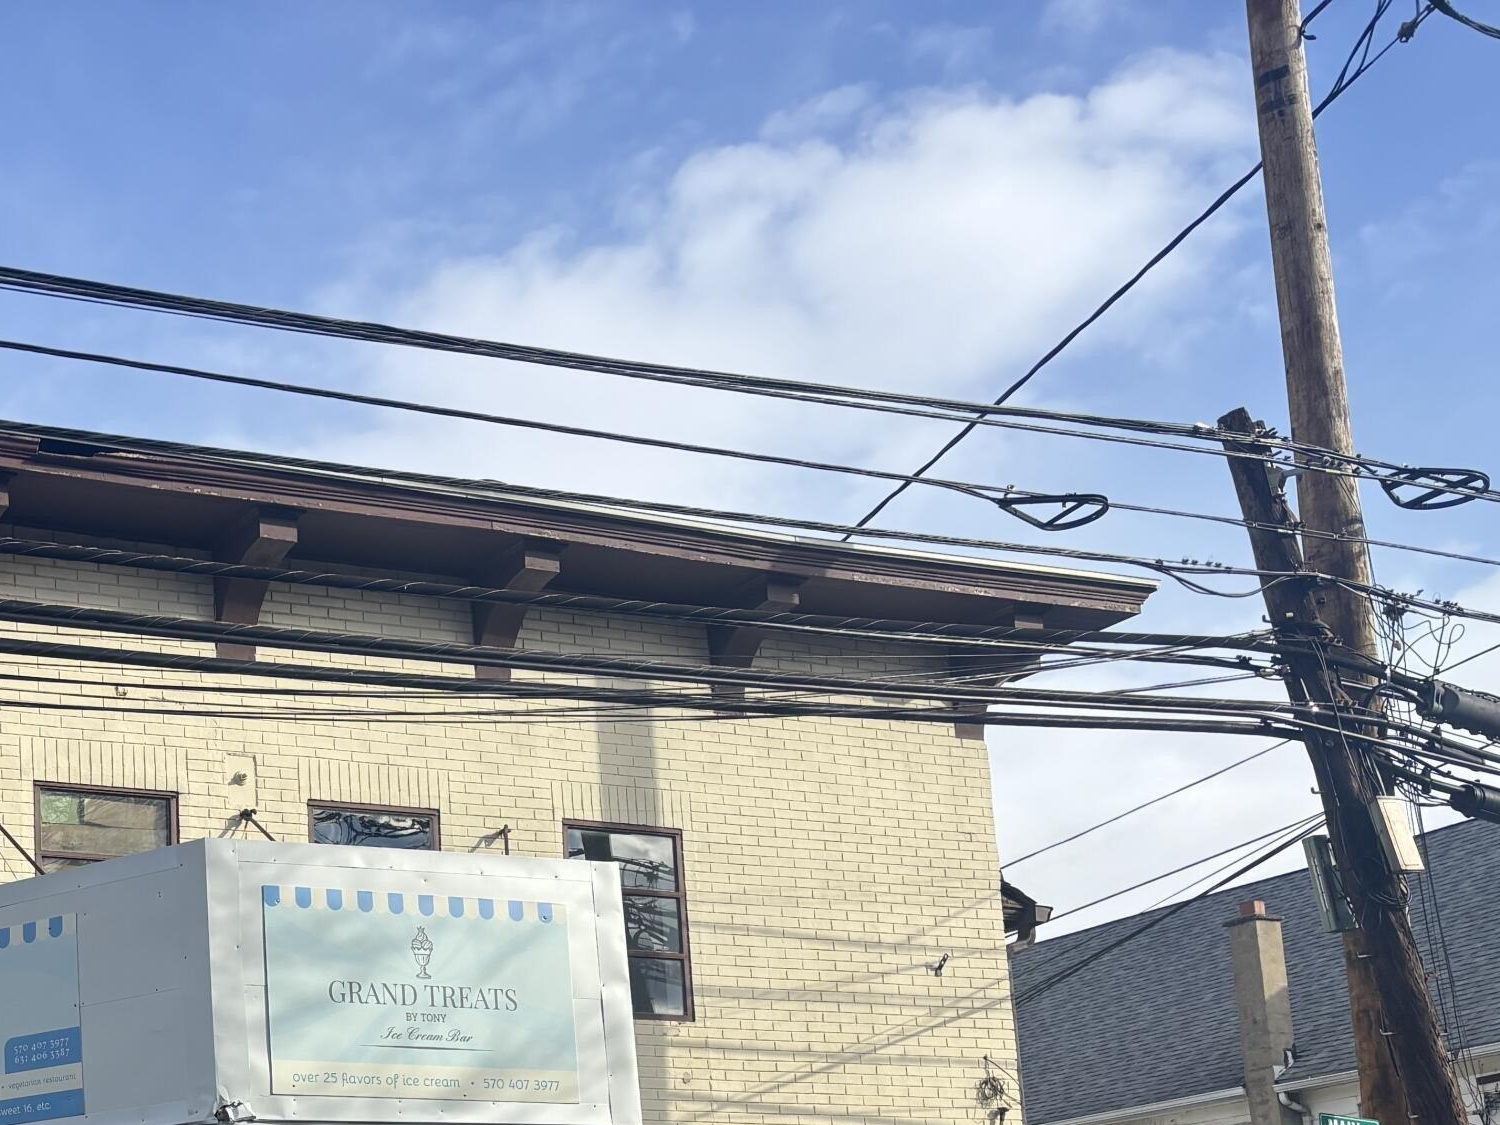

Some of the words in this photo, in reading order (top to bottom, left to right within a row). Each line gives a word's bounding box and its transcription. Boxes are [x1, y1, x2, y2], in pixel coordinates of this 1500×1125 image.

[328, 980, 418, 1007] GRAND
[424, 984, 518, 1012] TREATS
[406, 1012, 419, 1022] BY
[420, 1013, 447, 1023] TONY
[380, 1027, 403, 1040] Ice
[406, 1027, 444, 1042] Cream
[445, 1029, 473, 1043] Bar
[13, 1044, 29, 1055] 570
[31, 1041, 47, 1051] 407
[8, 1079, 41, 1091] vegetarian
[43, 1073, 77, 1084] restaurant
[292, 1072, 320, 1083] over
[323, 1072, 338, 1083] 25
[341, 1072, 382, 1087] flavors
[385, 1073, 399, 1089] of
[402, 1074, 420, 1087] ice
[423, 1077, 461, 1088] cream
[483, 1078, 505, 1090] 570
[508, 1079, 529, 1091] 407
[533, 1079, 560, 1092] 3977
